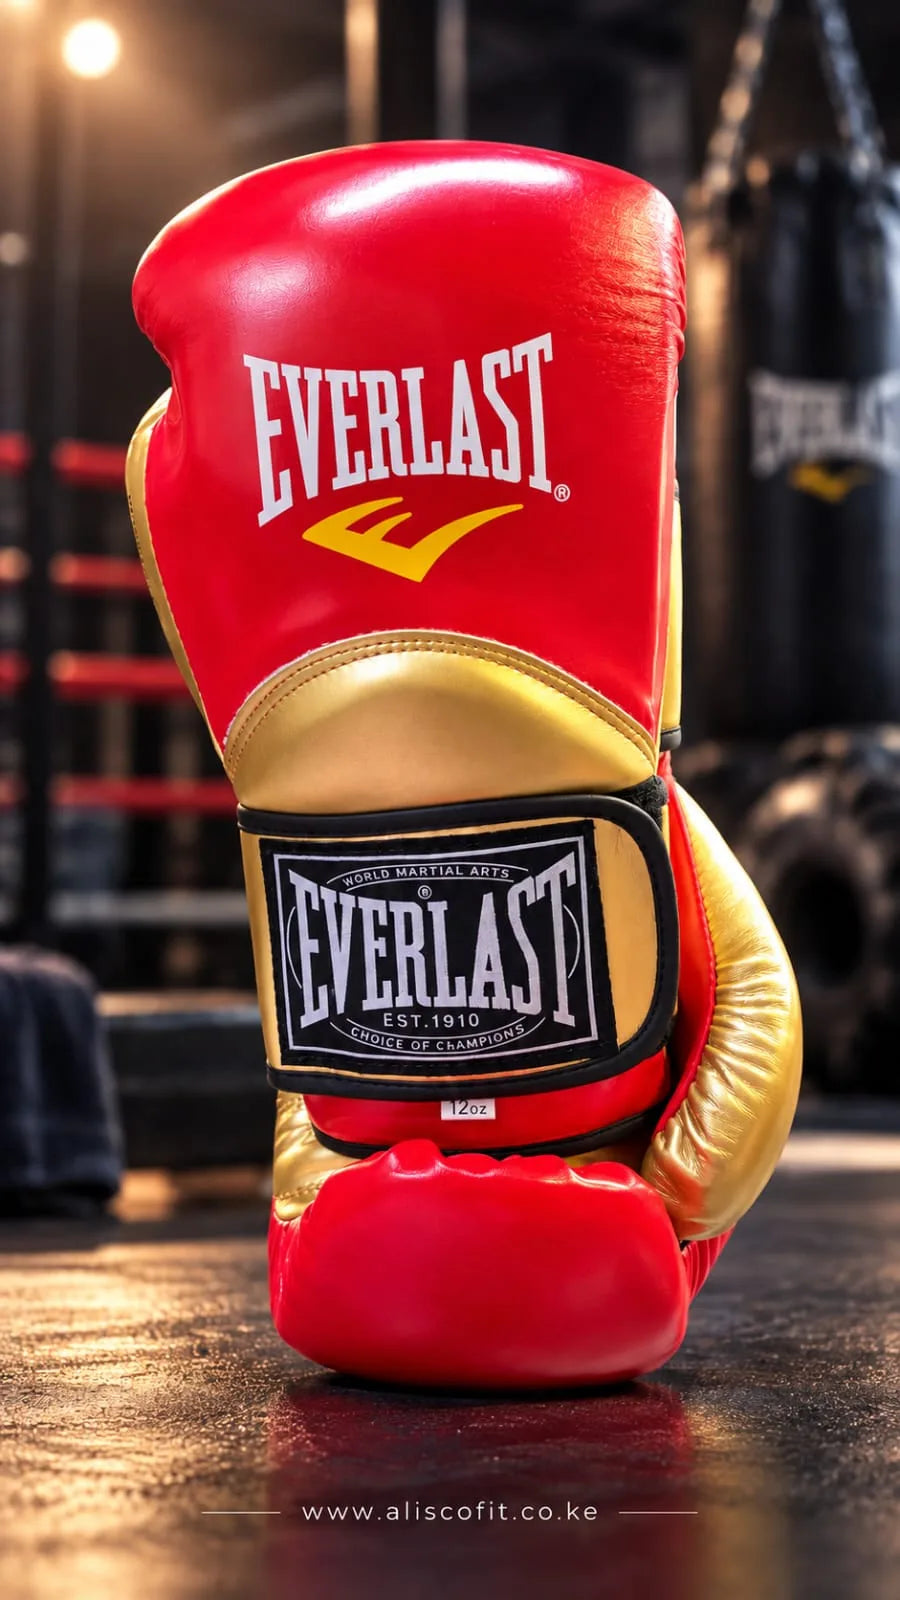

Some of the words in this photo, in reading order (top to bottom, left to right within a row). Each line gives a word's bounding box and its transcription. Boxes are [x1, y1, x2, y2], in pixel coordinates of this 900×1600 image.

[342, 869, 390, 887] WORLD
[396, 866, 464, 878] MARTIAL
[470, 866, 510, 879] ARTS
[288, 851, 577, 1030] EVERLAST
[383, 1012, 480, 1028] EST.1910
[351, 1026, 404, 1050] CHOICE
[411, 1040, 431, 1051] OF
[451, 1099, 487, 1116] 12oz
